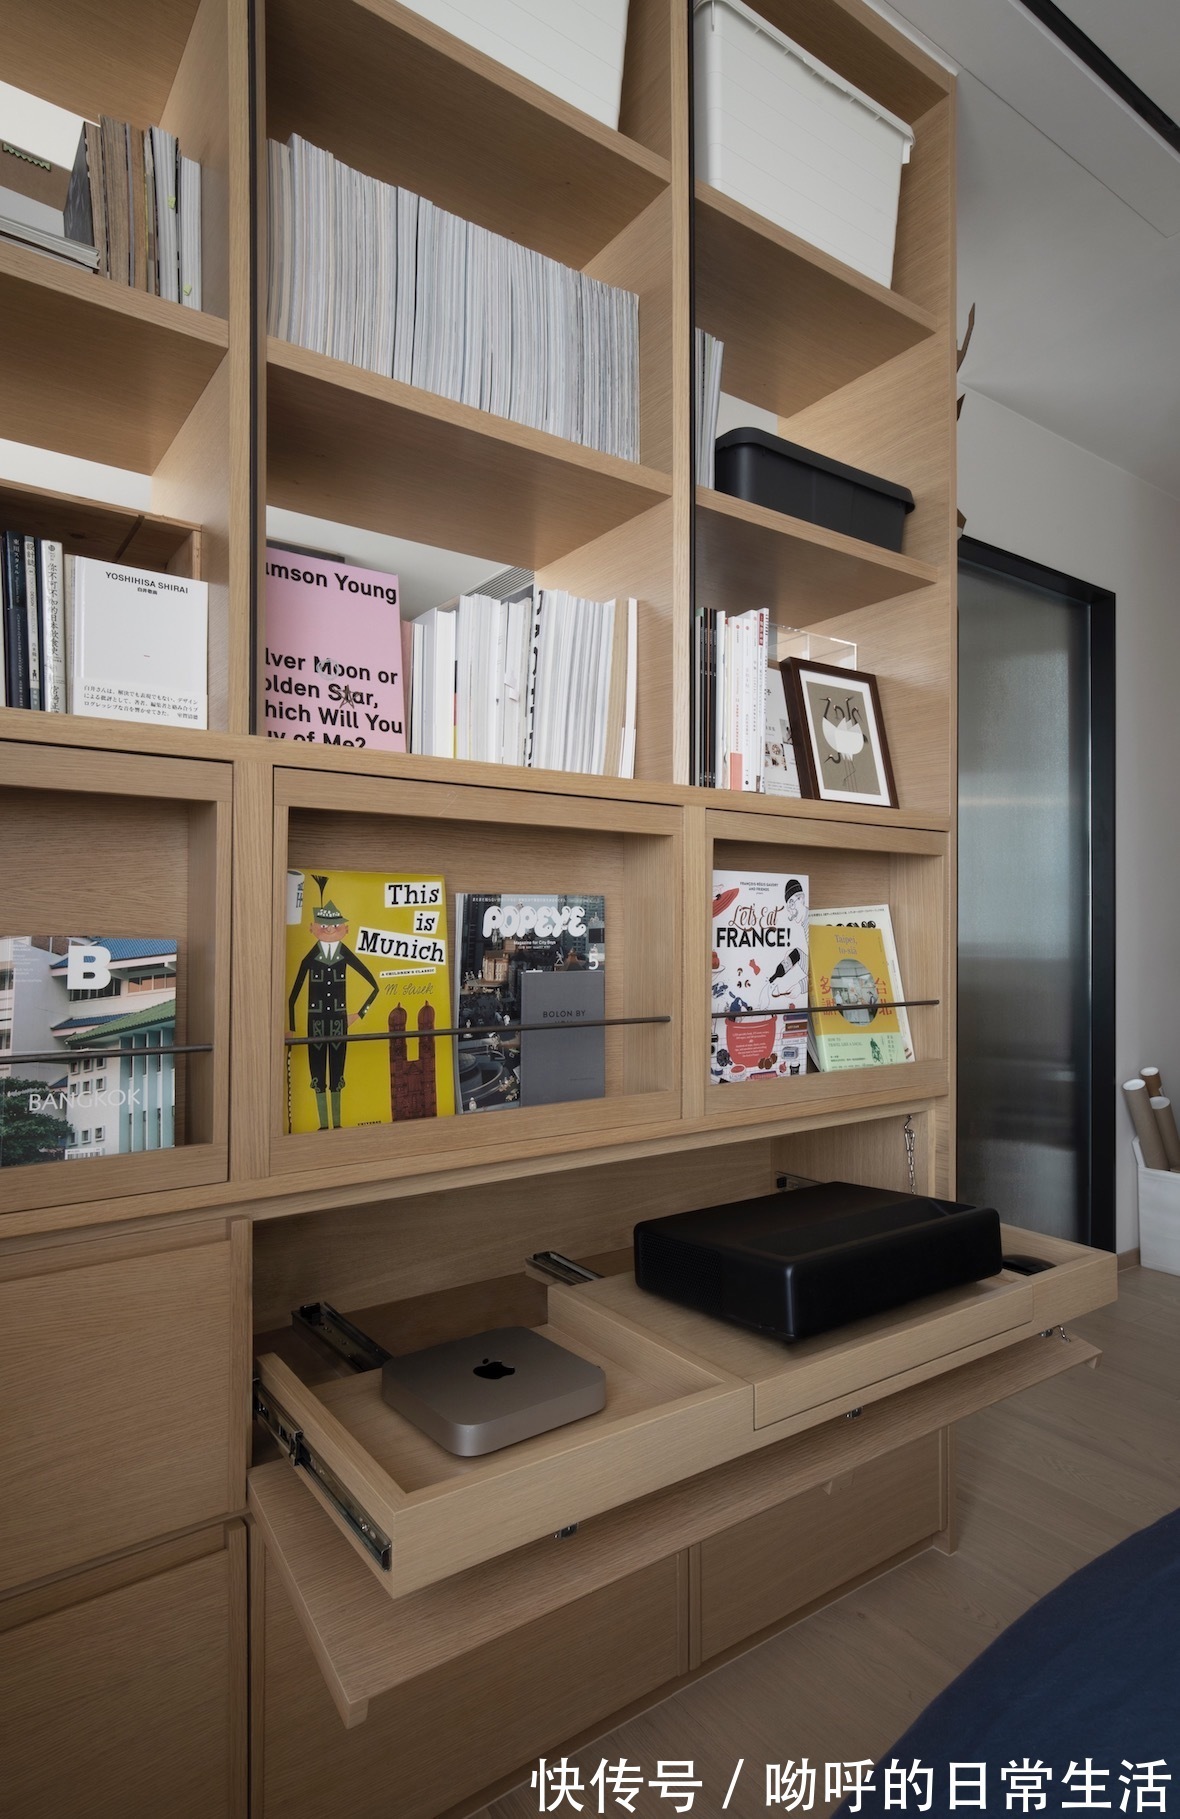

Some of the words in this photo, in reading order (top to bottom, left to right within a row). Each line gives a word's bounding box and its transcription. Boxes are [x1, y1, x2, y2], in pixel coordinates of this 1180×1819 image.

[105, 571, 156, 588] YOSHIHISA
[158, 582, 188, 594] SHIRAI
[266, 563, 328, 588] mson
[334, 572, 397, 605] Young
[314, 656, 370, 681] Moon
[378, 669, 398, 685] or
[328, 684, 378, 709] Star,
[318, 706, 359, 729] Will
[365, 713, 403, 734] You
[388, 884, 440, 905] This
[415, 913, 435, 931] is
[482, 905, 587, 938] POPEYE
[759, 905, 785, 932] Eat
[358, 930, 444, 963] Munich
[716, 927, 791, 948] FRANCE!
[66, 945, 112, 990] B
[588, 953, 599, 970] 5
[542, 1010, 573, 1018] BOLON
[575, 1009, 586, 1017] BY
[28, 1088, 141, 1112] BANGKOK
